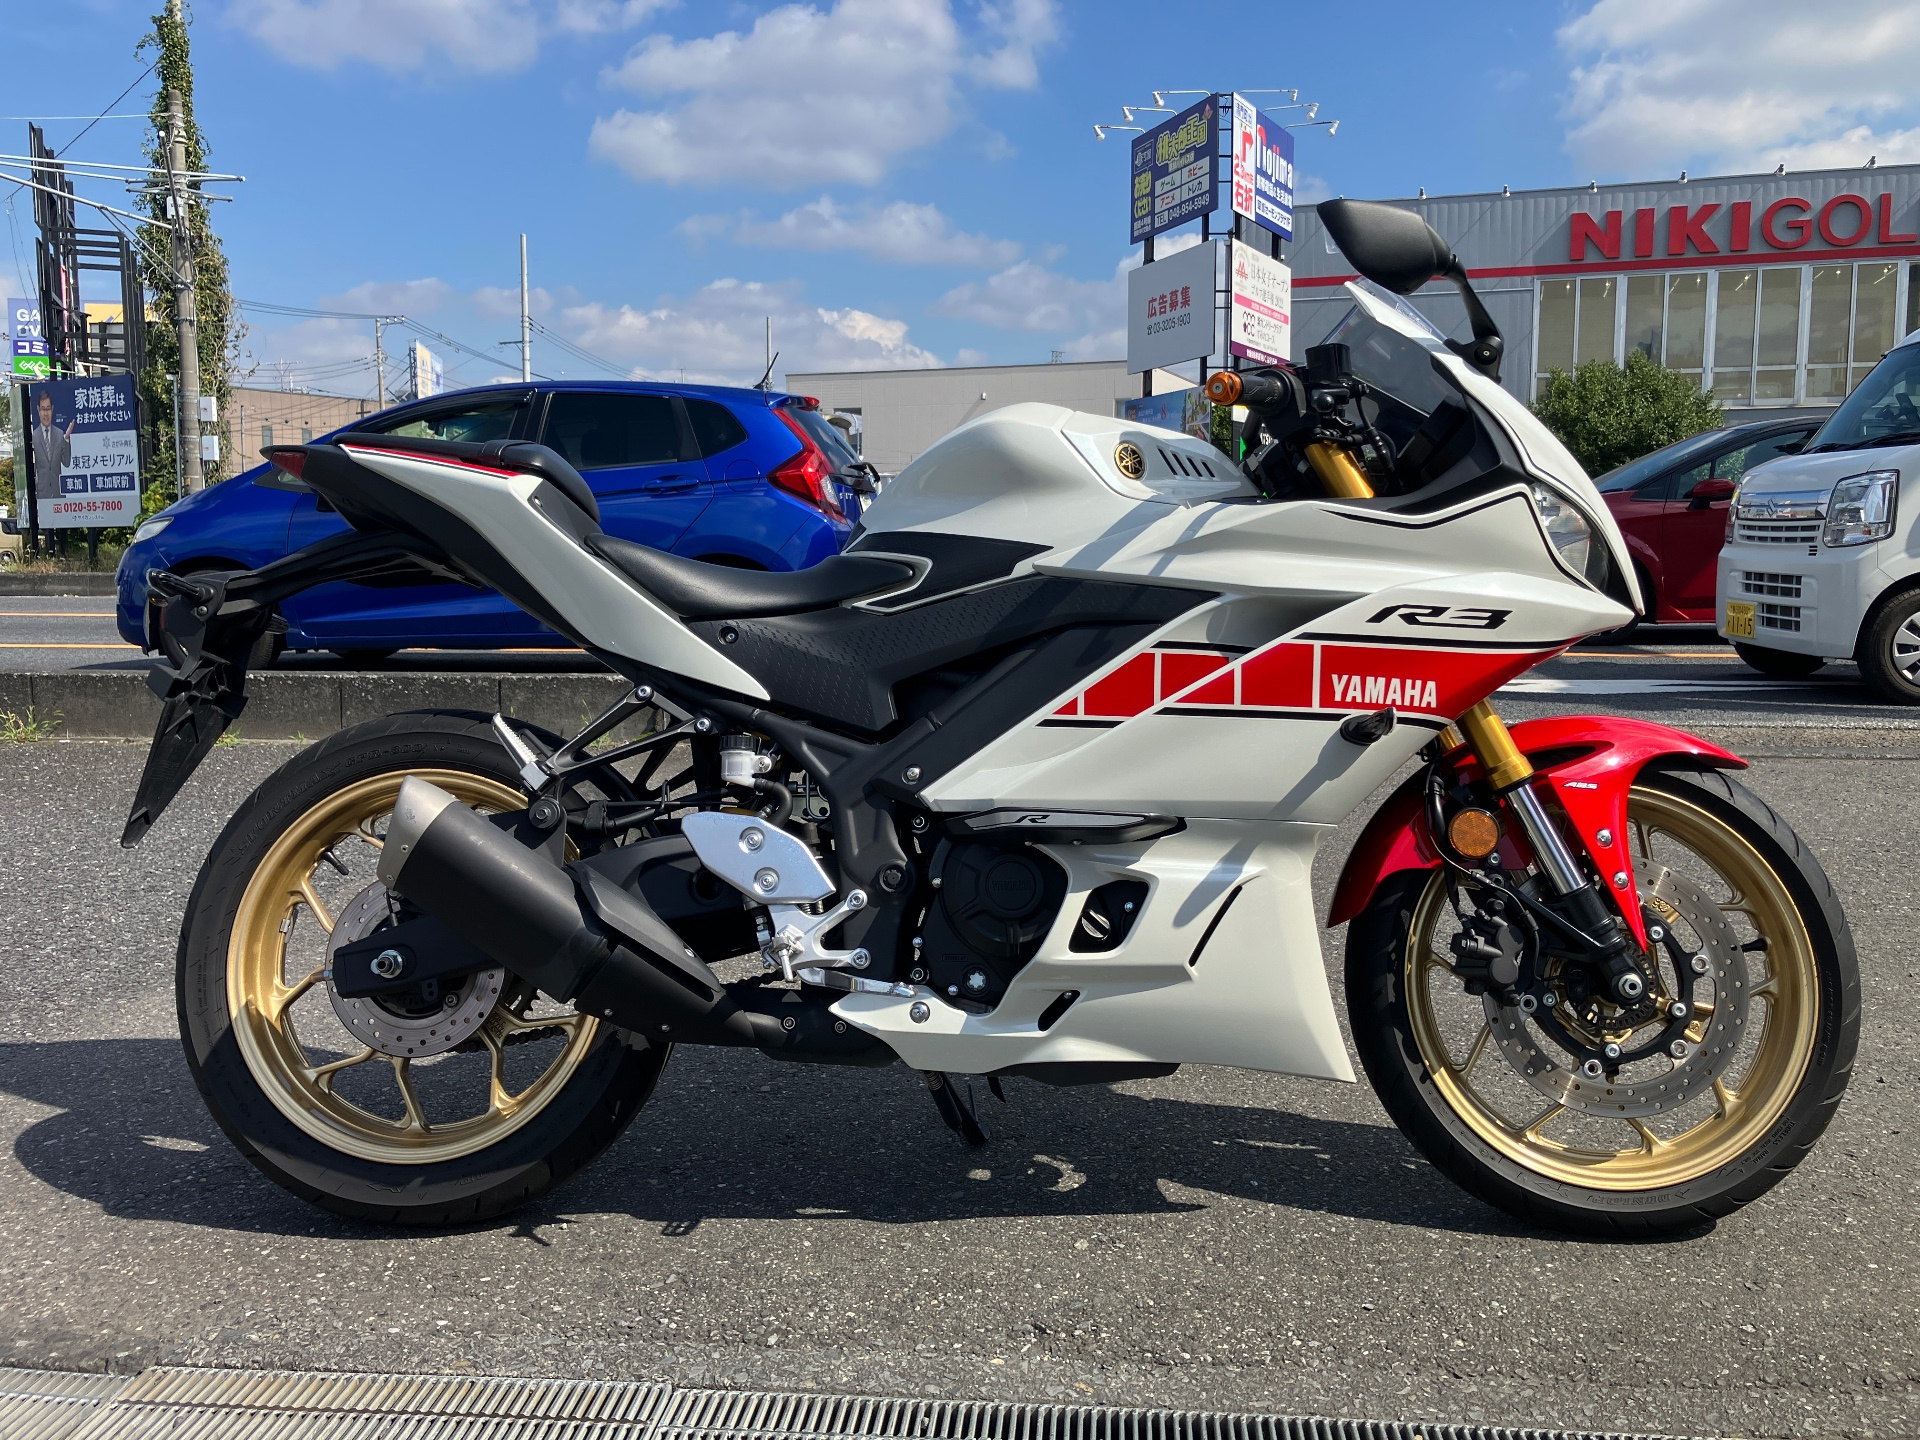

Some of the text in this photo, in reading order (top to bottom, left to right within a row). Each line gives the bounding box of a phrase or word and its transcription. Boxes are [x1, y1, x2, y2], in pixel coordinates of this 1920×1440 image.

[1156, 113, 1207, 166] 桃太郎王国
[1187, 165, 1203, 178] ホビー
[1160, 175, 1175, 192] ゲーム
[1187, 181, 1203, 196] トレカ
[1160, 193, 1175, 208] アニメ
[1234, 181, 1253, 215] 右折
[1156, 214, 1166, 226] TEL
[1569, 193, 1918, 261] NIKIGOL
[1147, 286, 1191, 319] 広告募集
[1152, 313, 1191, 335] 03-3205-1903
[17, 341, 45, 354] コミ
[74, 385, 125, 410] 家族葬は
[76, 410, 131, 424] おまかせください
[72, 454, 134, 470] 東冠メモリアル
[65, 475, 129, 490] 草加 草加駅前
[63, 500, 123, 513] 0120-55-7800
[1365, 603, 1513, 630] R3
[1331, 674, 1437, 708] YAMAHA
[1564, 780, 1599, 790] ABS
[1591, 1194, 1671, 1206] DUNLOP
